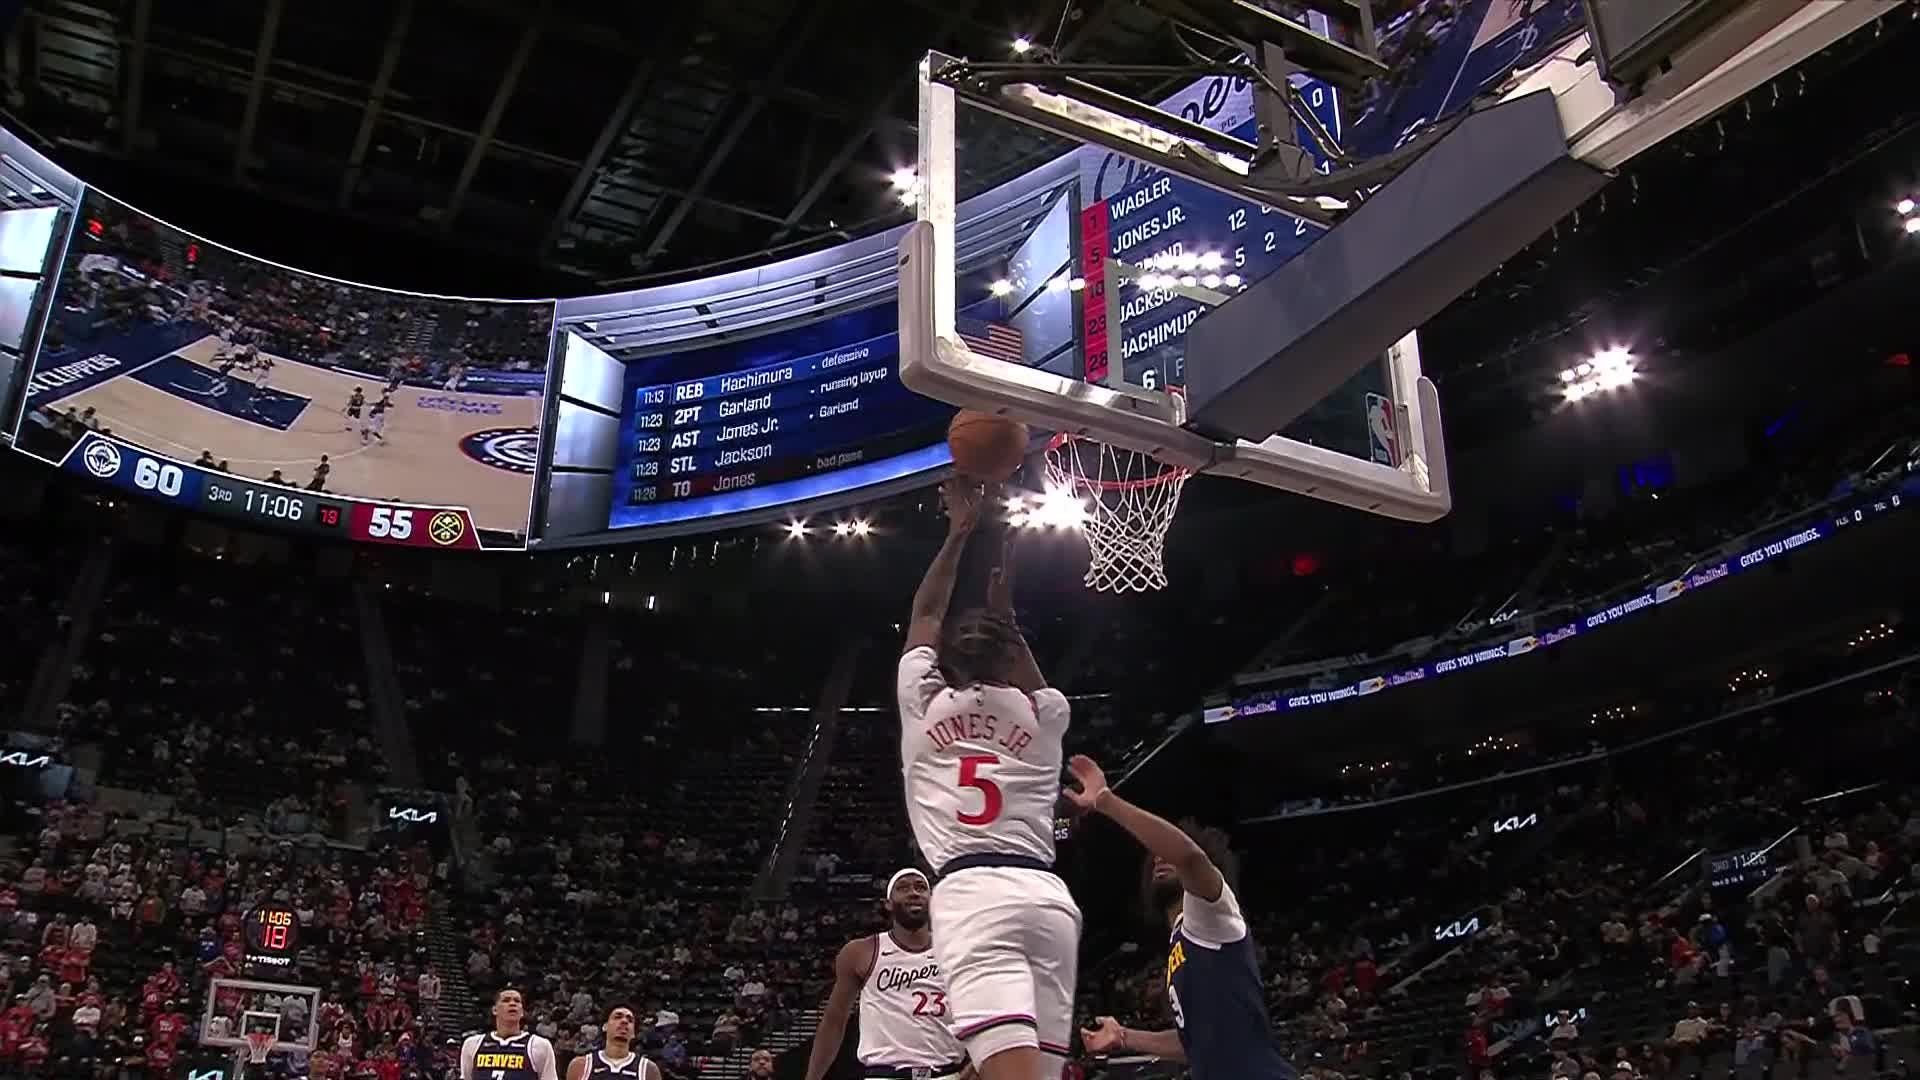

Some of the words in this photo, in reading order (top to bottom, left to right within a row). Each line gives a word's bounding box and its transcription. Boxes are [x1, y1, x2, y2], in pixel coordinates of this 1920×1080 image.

[1111, 178, 1172, 220] WAGLER
[1113, 218, 1160, 254] JONES
[1162, 206, 1186, 230] JR.
[1228, 209, 1246, 232] 12
[1264, 231, 1276, 253] 2
[1235, 247, 1246, 268] 5
[1120, 287, 1179, 323] JACKSO
[644, 390, 664, 404] 11:13
[676, 382, 703, 400] REB
[721, 366, 792, 392] Hachimura
[1143, 370, 1154, 390] 6
[641, 414, 662, 428] 11:23
[674, 406, 702, 425] 2PT
[720, 392, 771, 417] Garland
[639, 438, 660, 452] 11:23
[672, 430, 700, 449] AST
[717, 422, 758, 441] Jones
[761, 417, 779, 433] Jr.
[820, 398, 859, 418] Garland
[636, 462, 658, 477] 11:28
[670, 456, 696, 473] STL
[715, 444, 772, 466] Jackson
[134, 457, 184, 496] 60
[672, 480, 690, 497] TO
[713, 472, 756, 491] Jones
[208, 486, 232, 501] 3RD
[244, 490, 304, 521] 11:06
[1854, 510, 1862, 521] 0
[1892, 494, 1900, 507] 0
[368, 507, 412, 539] 55
[1764, 542, 1782, 558] YOU
[1607, 605, 1624, 620] YOU
[1458, 654, 1474, 668] YOU
[1310, 691, 1327, 704] YOU
[926, 713, 998, 753] JONES
[999, 724, 1032, 760] JR
[956, 754, 1003, 826] 5
[258, 910, 292, 926] 11:06
[877, 964, 940, 992] Clipper
[911, 991, 947, 1018] 23
[474, 1053, 524, 1070] DENVER
